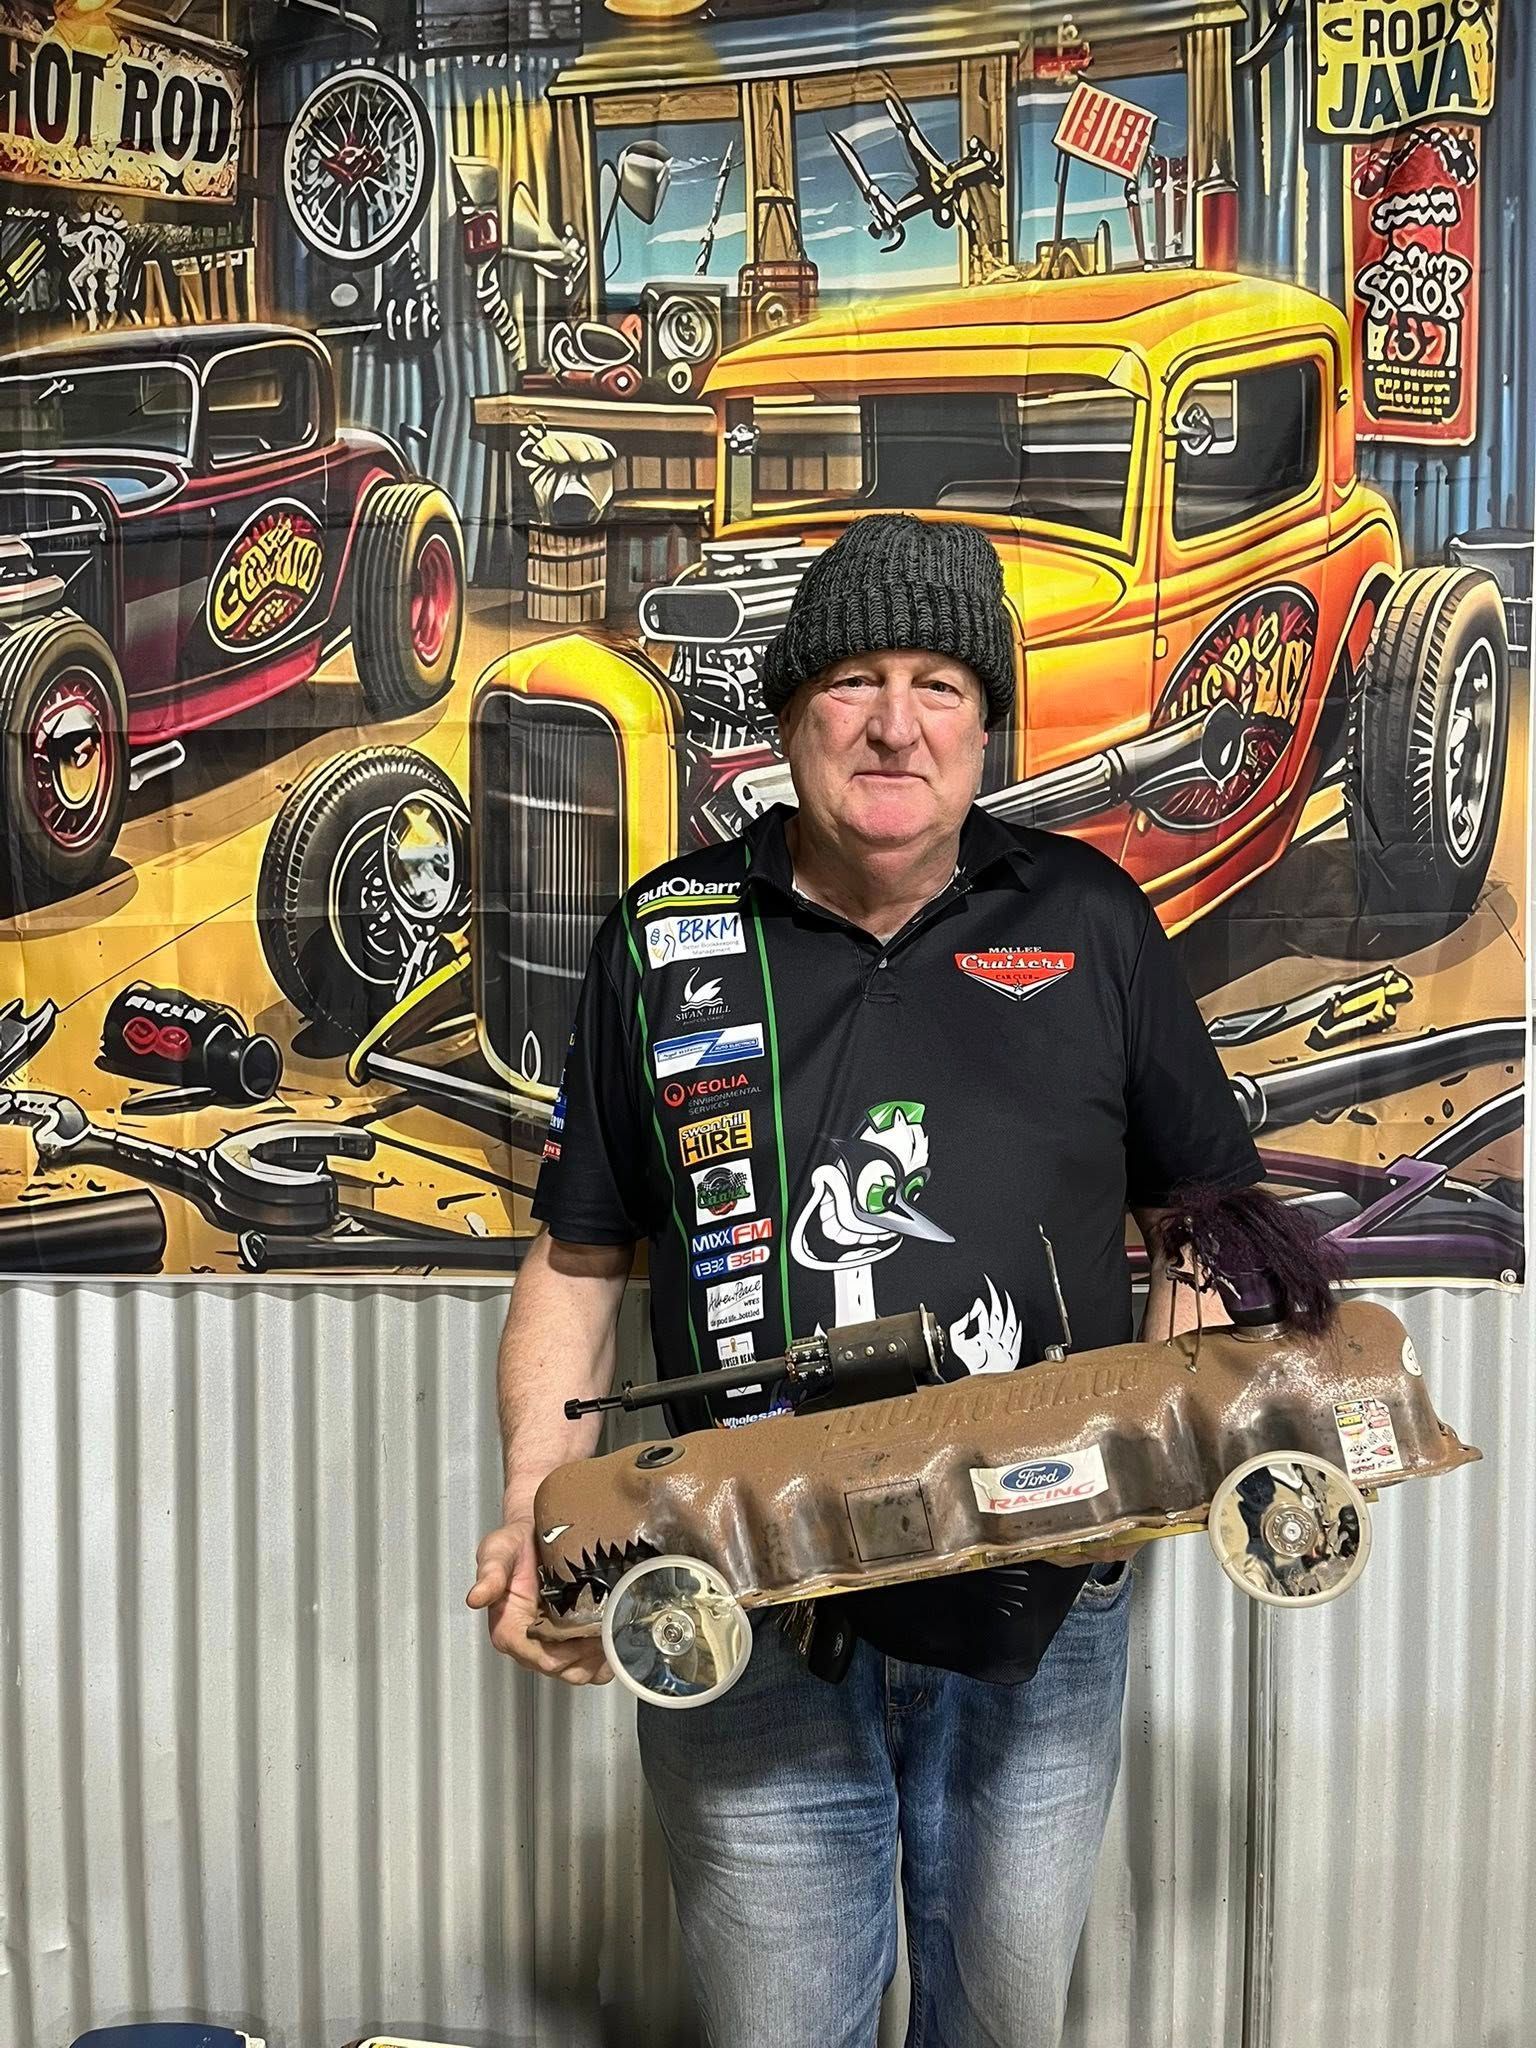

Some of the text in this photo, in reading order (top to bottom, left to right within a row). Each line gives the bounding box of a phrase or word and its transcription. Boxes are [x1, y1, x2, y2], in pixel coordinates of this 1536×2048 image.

[1362, 2, 1446, 58] ROD
[1328, 38, 1478, 129] JAVA
[0, 41, 234, 164] HOT ROD
[677, 914, 740, 943] BBKM
[961, 954, 1068, 970] Cruisers
[988, 946, 1042, 954] MALLEE
[675, 1009, 704, 1023] SWAN
[707, 1005, 732, 1016] HILL
[687, 1073, 749, 1096] VEOLIA
[688, 1086, 762, 1107] ENVIRONMENTAL
[688, 1100, 730, 1116] SERVICES
[682, 1125, 749, 1164] HIRE
[692, 1220, 773, 1253] MIXX FM
[695, 1257, 725, 1277] 1332
[1015, 1465, 1059, 1489] Ford
[989, 1480, 1095, 1511] RACING
